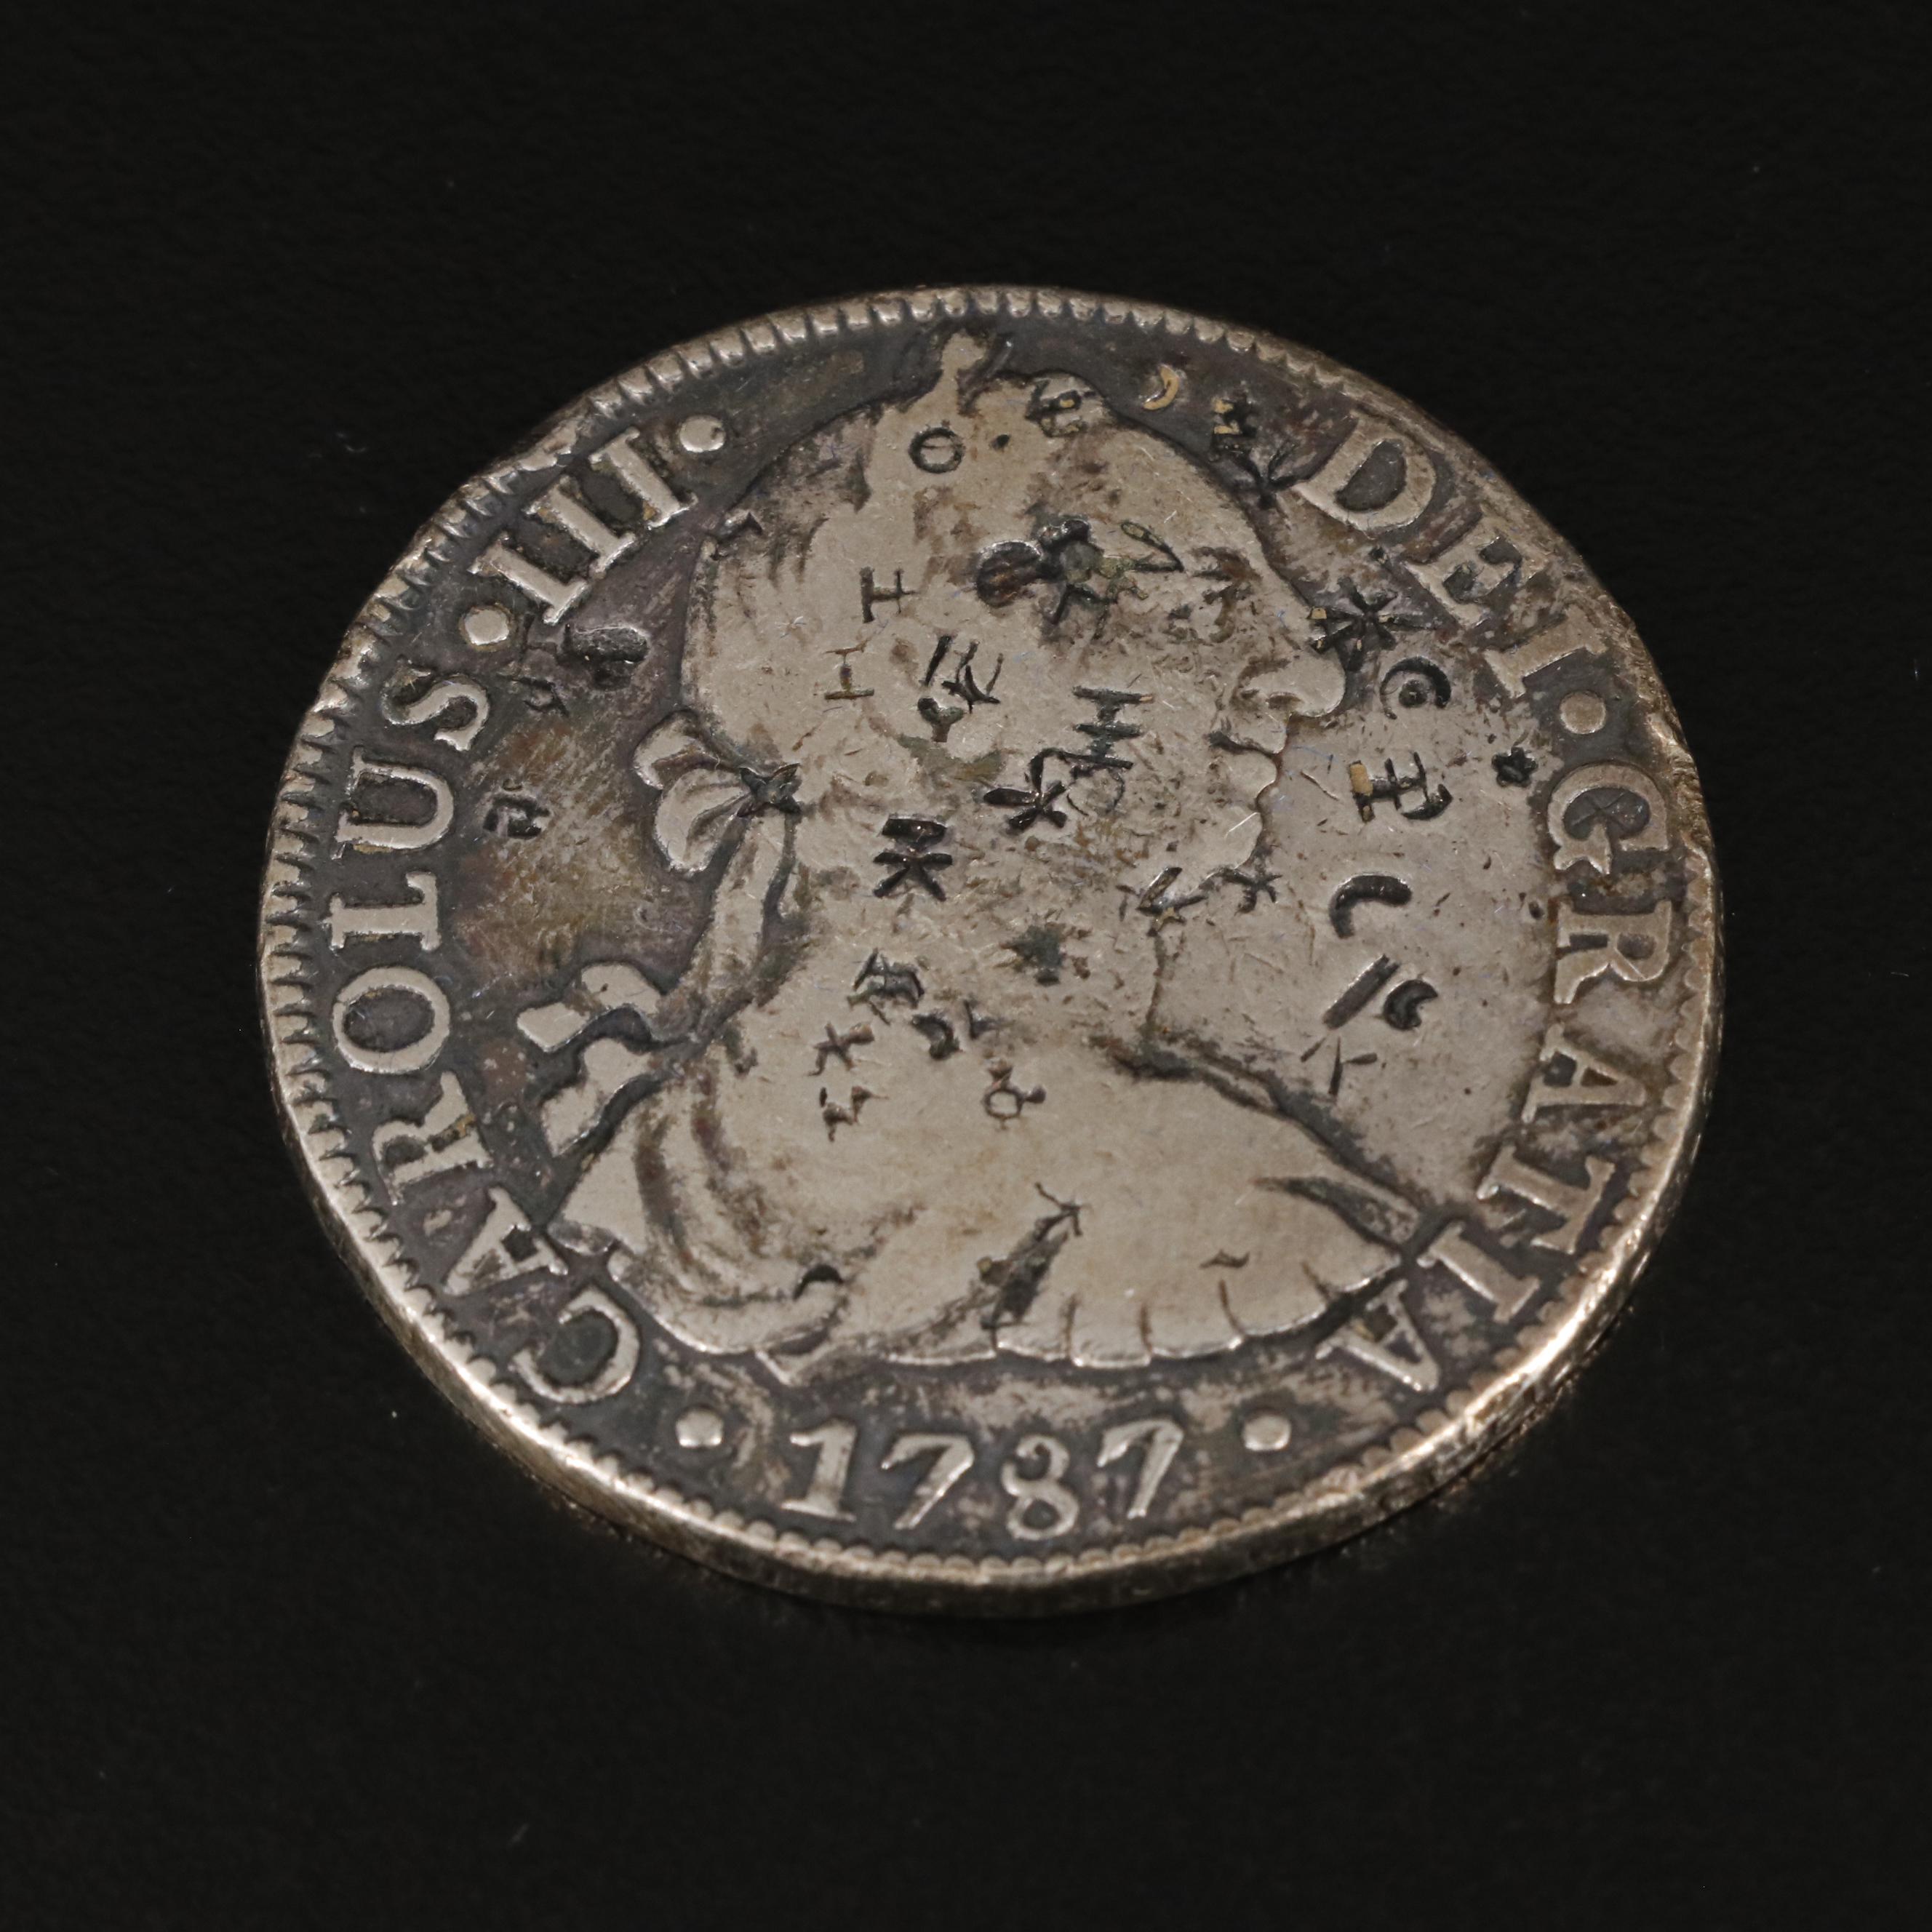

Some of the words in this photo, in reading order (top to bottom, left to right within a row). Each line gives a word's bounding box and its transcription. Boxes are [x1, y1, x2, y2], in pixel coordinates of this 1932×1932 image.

[468, 426, 698, 626] III
[1290, 410, 1608, 698] DEI
[329, 673, 640, 1404] CAROLUS
[1315, 760, 1672, 1392] GRATIA
[782, 1417, 1185, 1541] 1787
